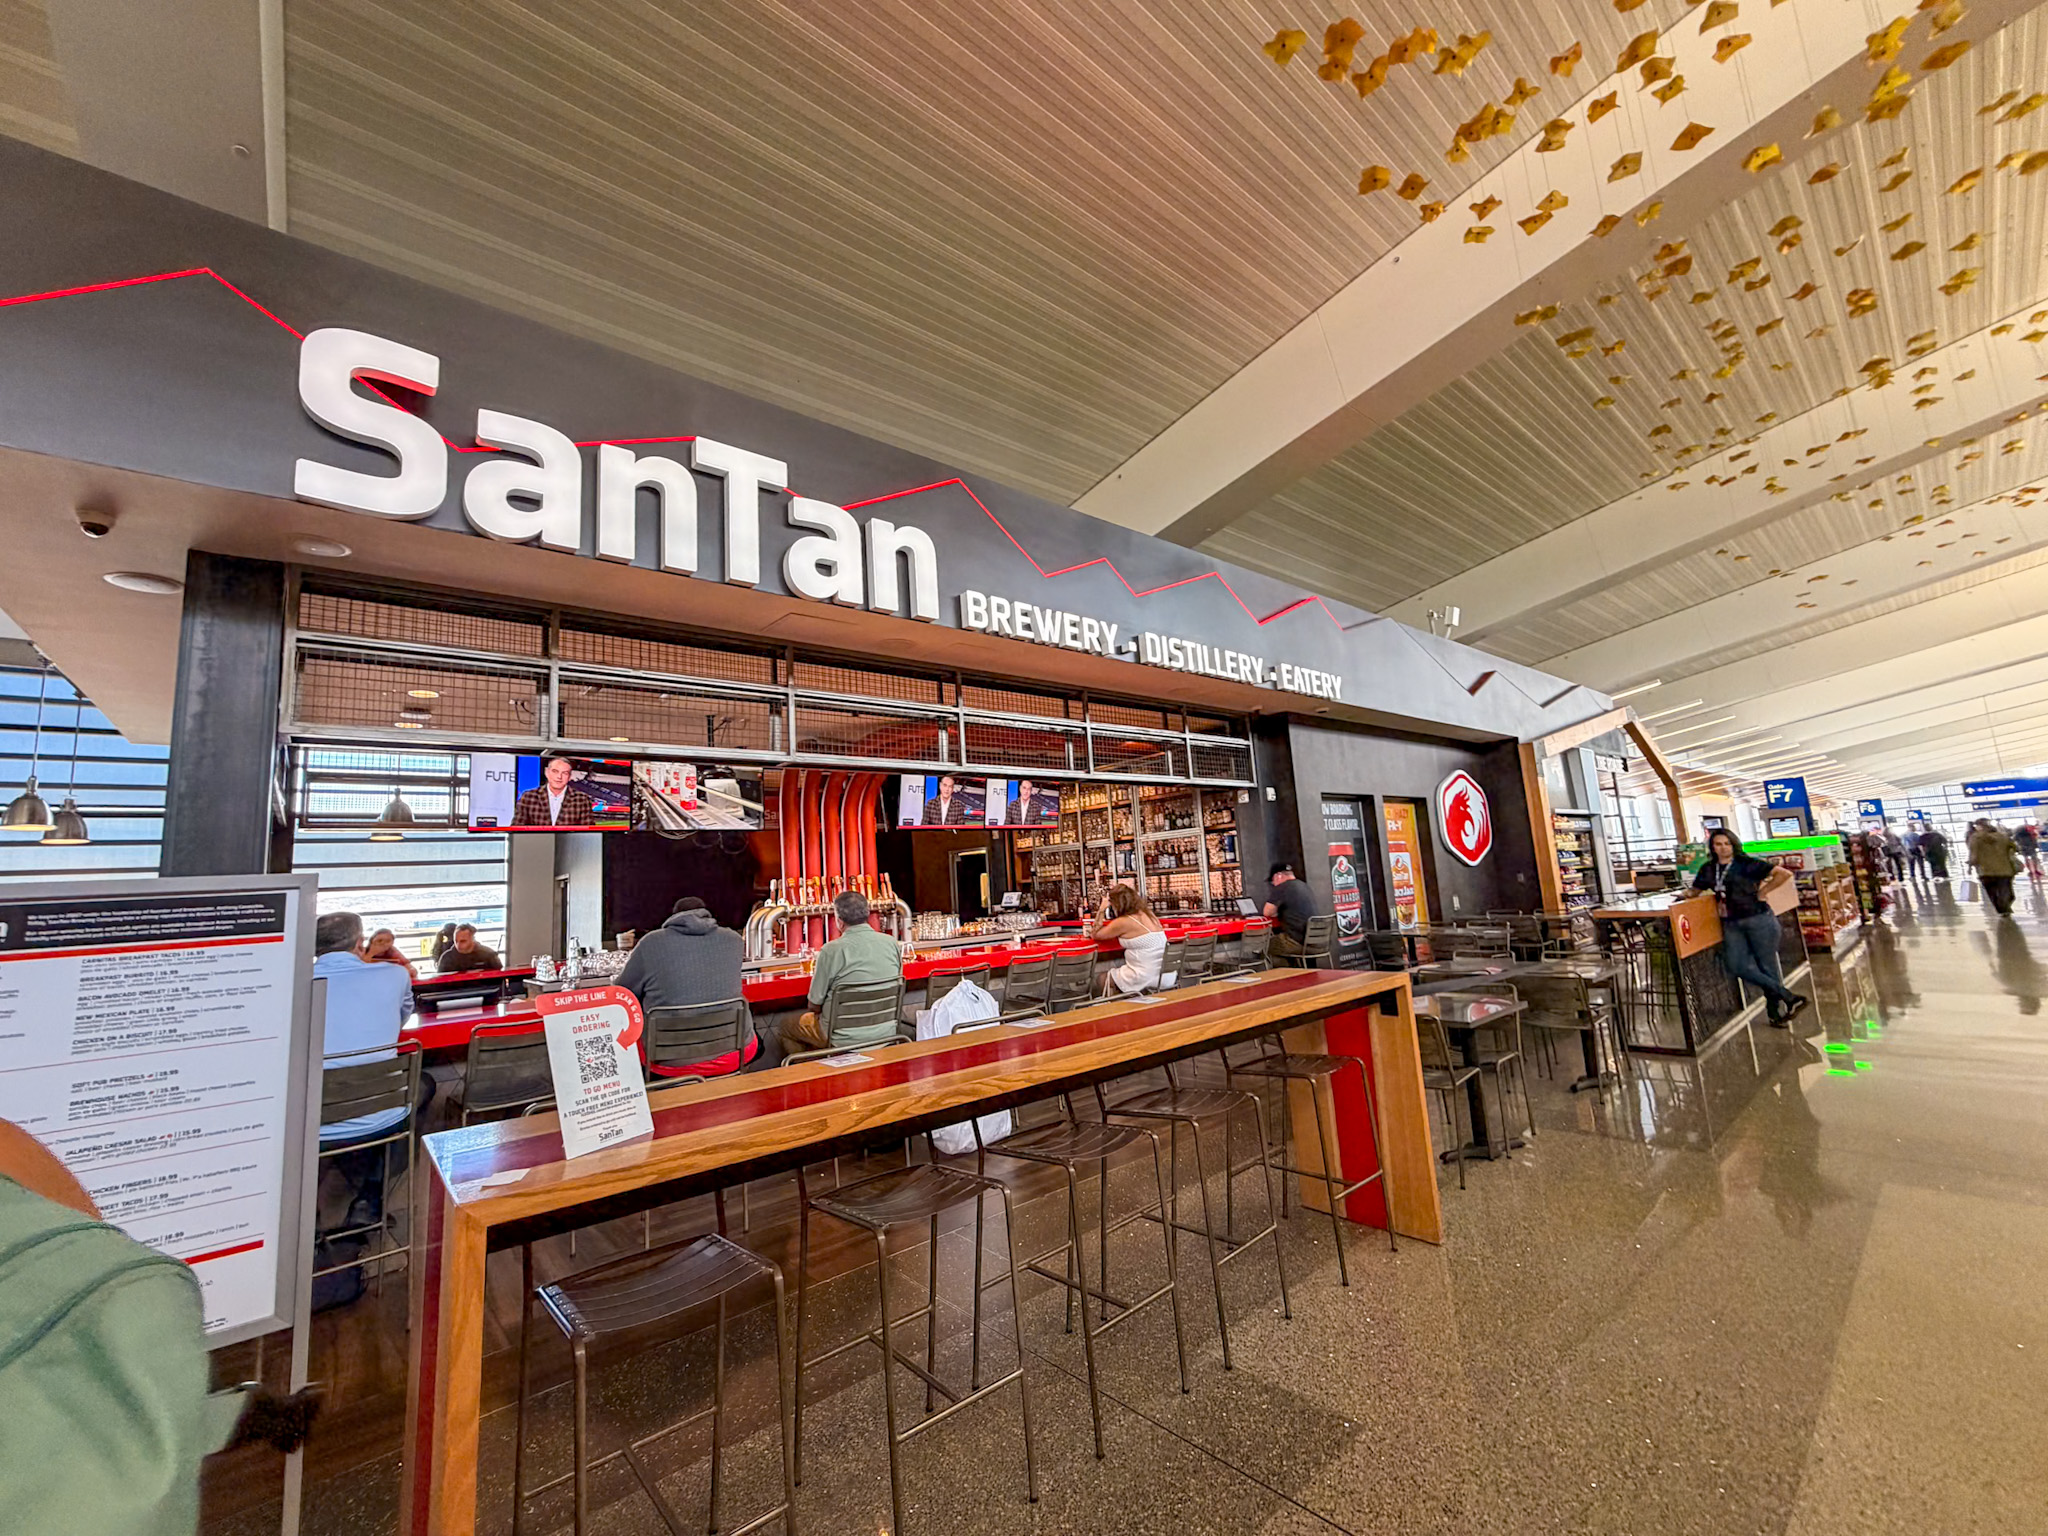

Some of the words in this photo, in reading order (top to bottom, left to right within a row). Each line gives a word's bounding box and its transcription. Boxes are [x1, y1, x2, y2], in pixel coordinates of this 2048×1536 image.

[294, 327, 940, 621] SanTan
[961, 589, 1118, 655] BREWERY
[1138, 631, 1264, 685] DISTILLERY
[1275, 663, 1342, 700] EATERY
[1768, 789, 1793, 804] F7
[1860, 804, 1876, 813] F8
[1334, 874, 1354, 885] SanTan
[118, 953, 159, 962] BREAKFAST
[160, 951, 181, 959] TACOS
[80, 973, 122, 982] BREAKFAST
[103, 991, 137, 999] AVOCADO
[554, 996, 573, 1006] SKIP
[573, 994, 589, 1003] THE
[590, 991, 607, 1000] LINE
[95, 1010, 127, 1019] MEXICAN
[128, 1008, 150, 1016] PLATE
[615, 992, 634, 1005] SCAN
[633, 1013, 641, 1023] GO
[580, 1013, 600, 1023] EASY
[572, 1021, 611, 1034] ORDERING
[72, 1036, 105, 1046] CHICKEN
[109, 1074, 145, 1083] PRETZELS
[593, 1085, 601, 1093] GO
[603, 1081, 621, 1090] MENU
[69, 1095, 115, 1106] BREWHOUSE
[118, 1090, 146, 1098] NACHOS
[575, 1098, 589, 1106] SCAN
[608, 1089, 621, 1097] CODE
[621, 1086, 631, 1094] FOR
[568, 1108, 585, 1117] TOUCH
[586, 1104, 599, 1112] FREE
[599, 1100, 613, 1108] MENU
[598, 1128, 624, 1141] SanTan
[104, 1139, 133, 1149] CAESAR
[134, 1135, 157, 1143] SALAD
[121, 1178, 153, 1189] FINGERS
